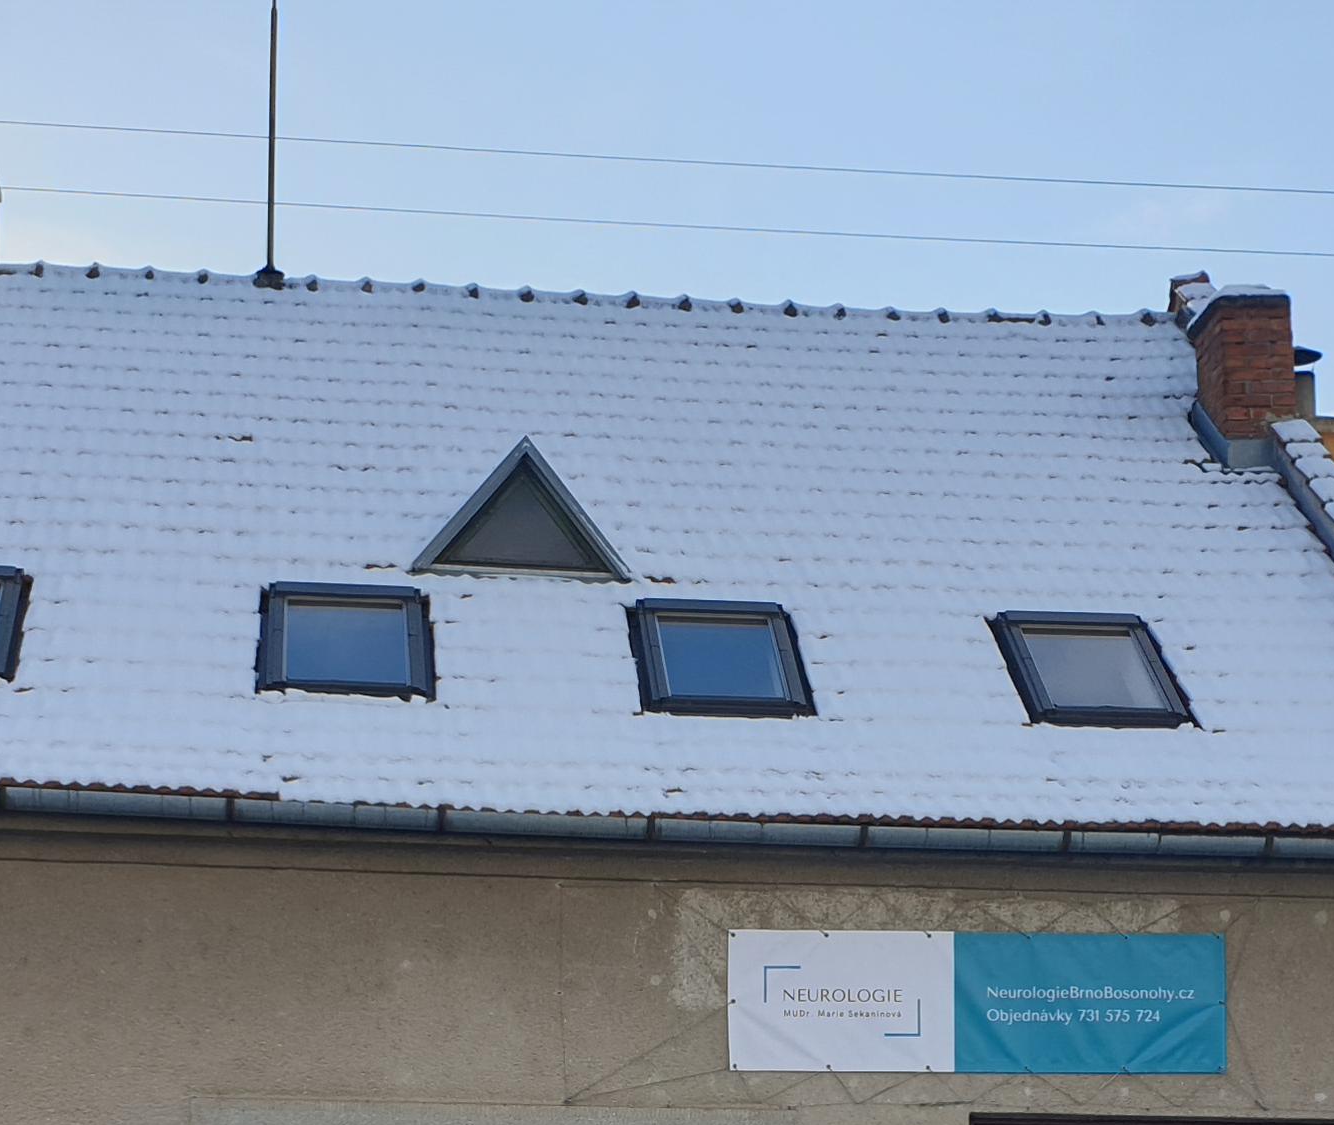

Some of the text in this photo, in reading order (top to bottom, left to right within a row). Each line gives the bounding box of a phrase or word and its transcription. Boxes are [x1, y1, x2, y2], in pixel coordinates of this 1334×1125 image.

[782, 988, 903, 1003] NEUROLOGIE
[986, 985, 1195, 1003] NeurologieBrnoBosonohy.cz
[817, 1009, 844, 1018] Marie
[986, 1008, 1161, 1025] Objednávky 731 575 724
